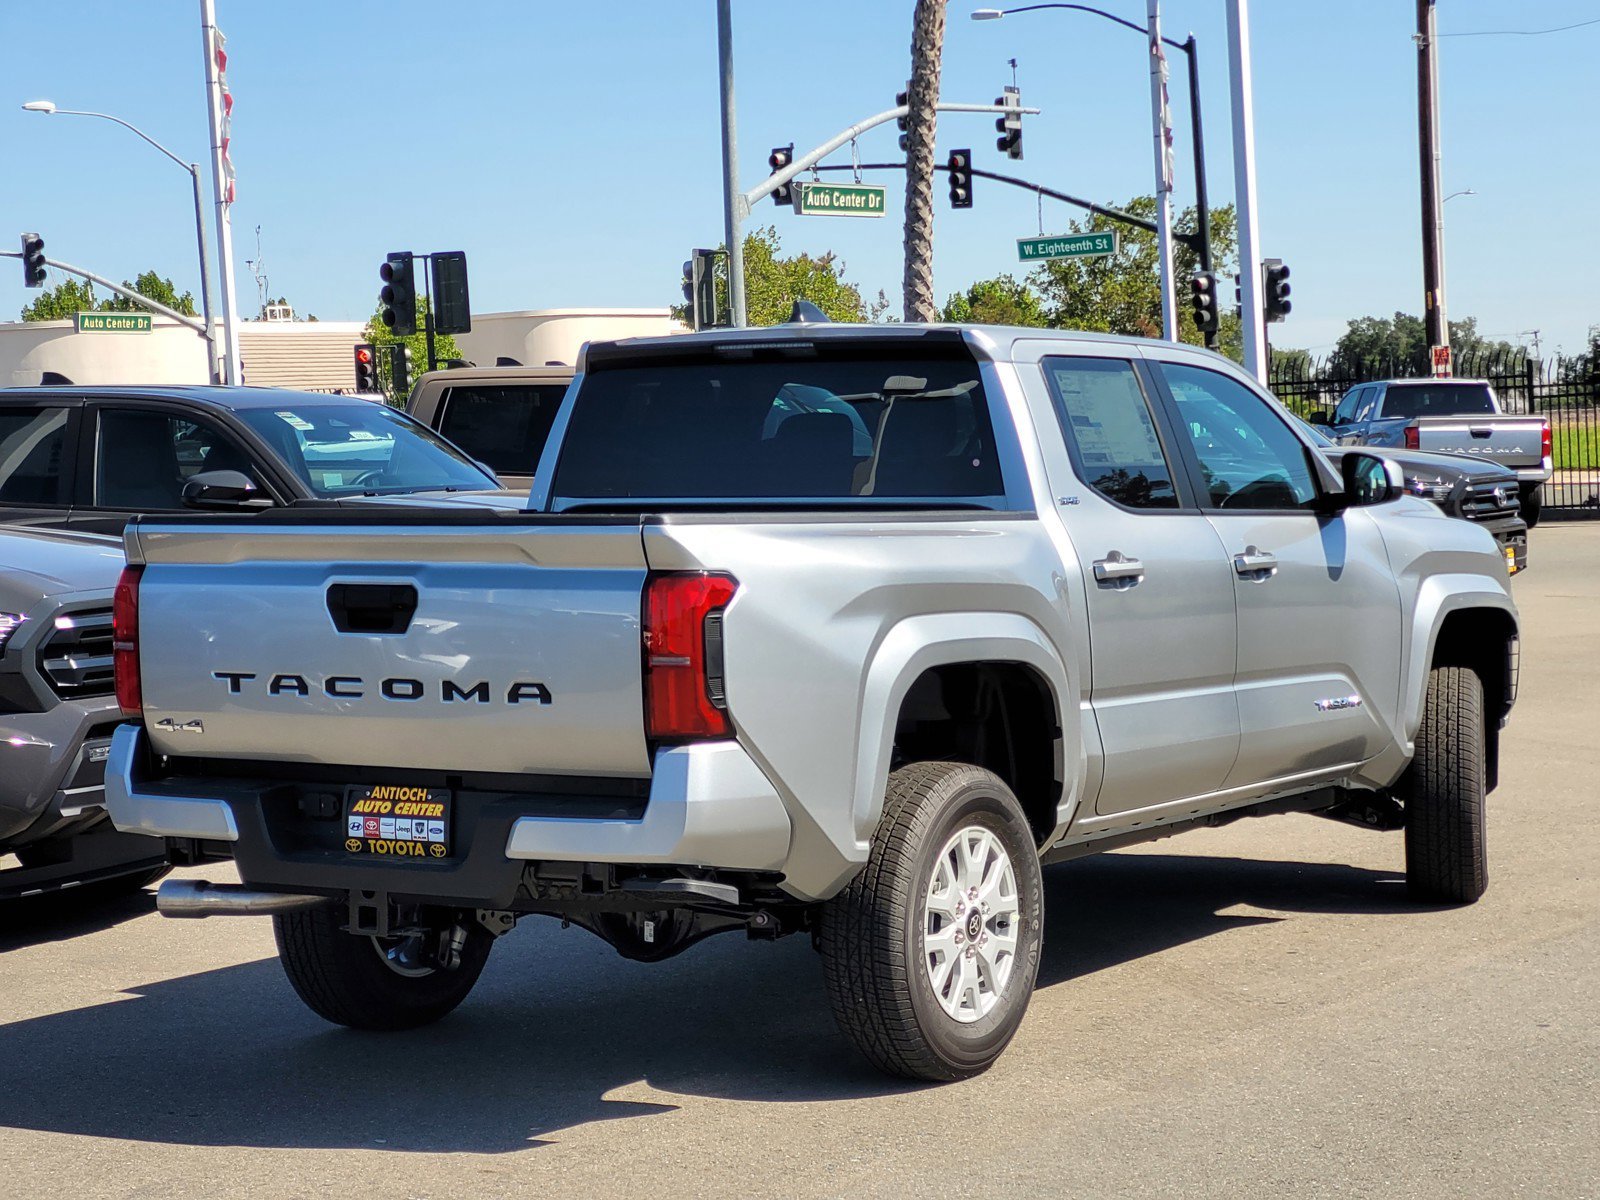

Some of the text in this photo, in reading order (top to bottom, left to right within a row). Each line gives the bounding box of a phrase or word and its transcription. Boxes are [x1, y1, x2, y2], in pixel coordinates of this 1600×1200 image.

[807, 190, 881, 208] Auto Center Dr
[1023, 238, 1108, 256] W. Eighteenth St
[84, 317, 148, 329] Auto Center Dr
[210, 671, 552, 706] TACOMA
[371, 786, 427, 801] ANTIOCH
[352, 800, 444, 816] AUTO CENTER
[396, 825, 411, 833] Jeep
[368, 840, 426, 856] TOYOTA
